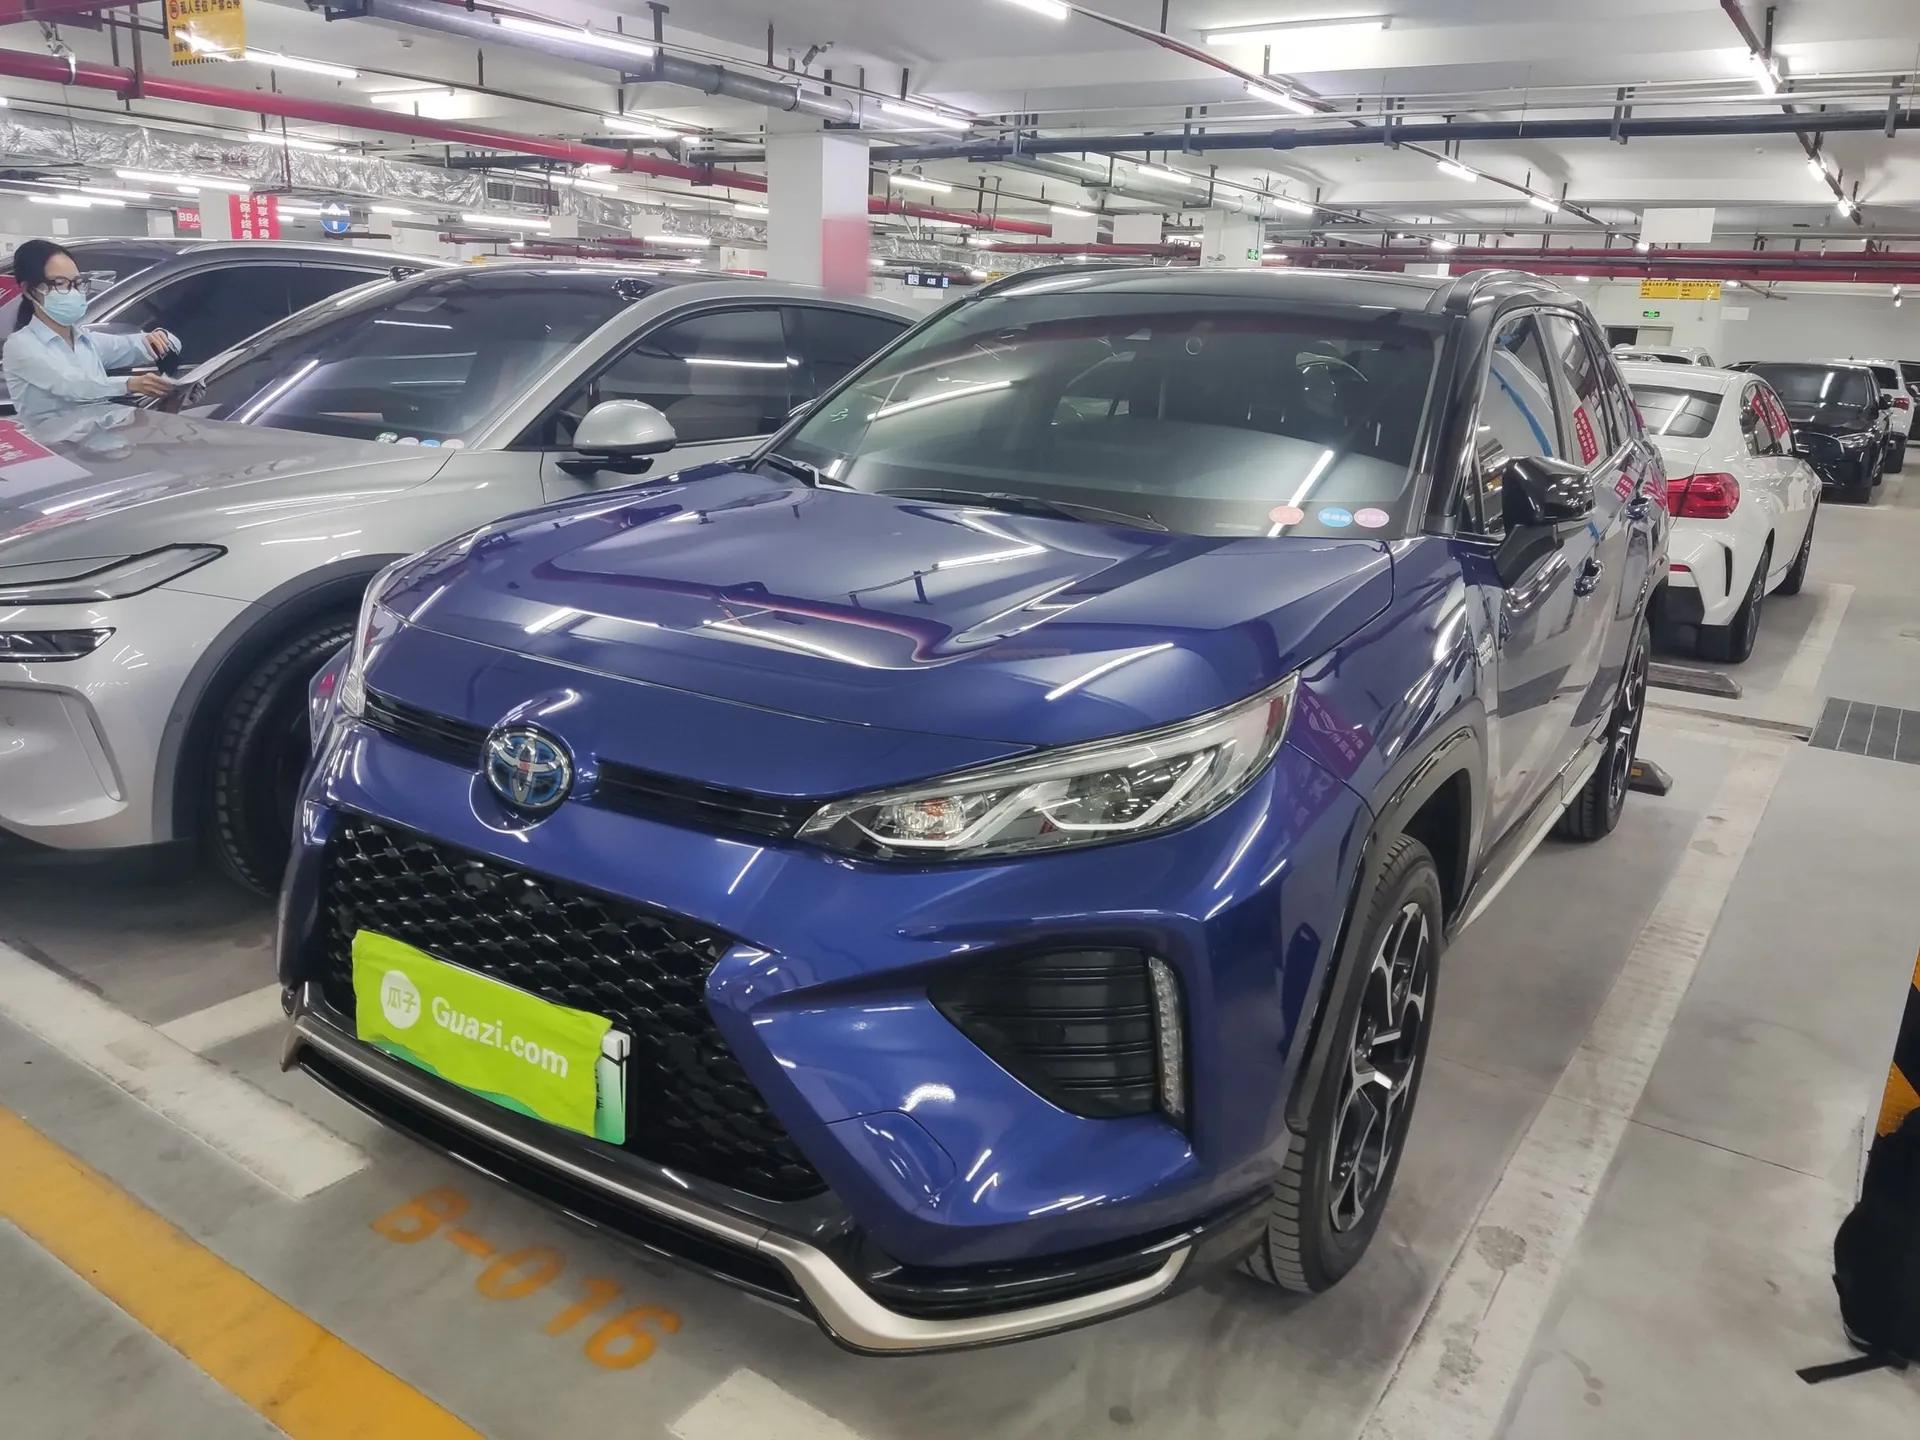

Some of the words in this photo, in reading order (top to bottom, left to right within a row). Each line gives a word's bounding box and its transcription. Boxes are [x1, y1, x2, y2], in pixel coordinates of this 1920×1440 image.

[387, 986, 416, 1013] 瓜子
[431, 996, 568, 1079] Guazi.com
[368, 1186, 683, 1370] B-016
